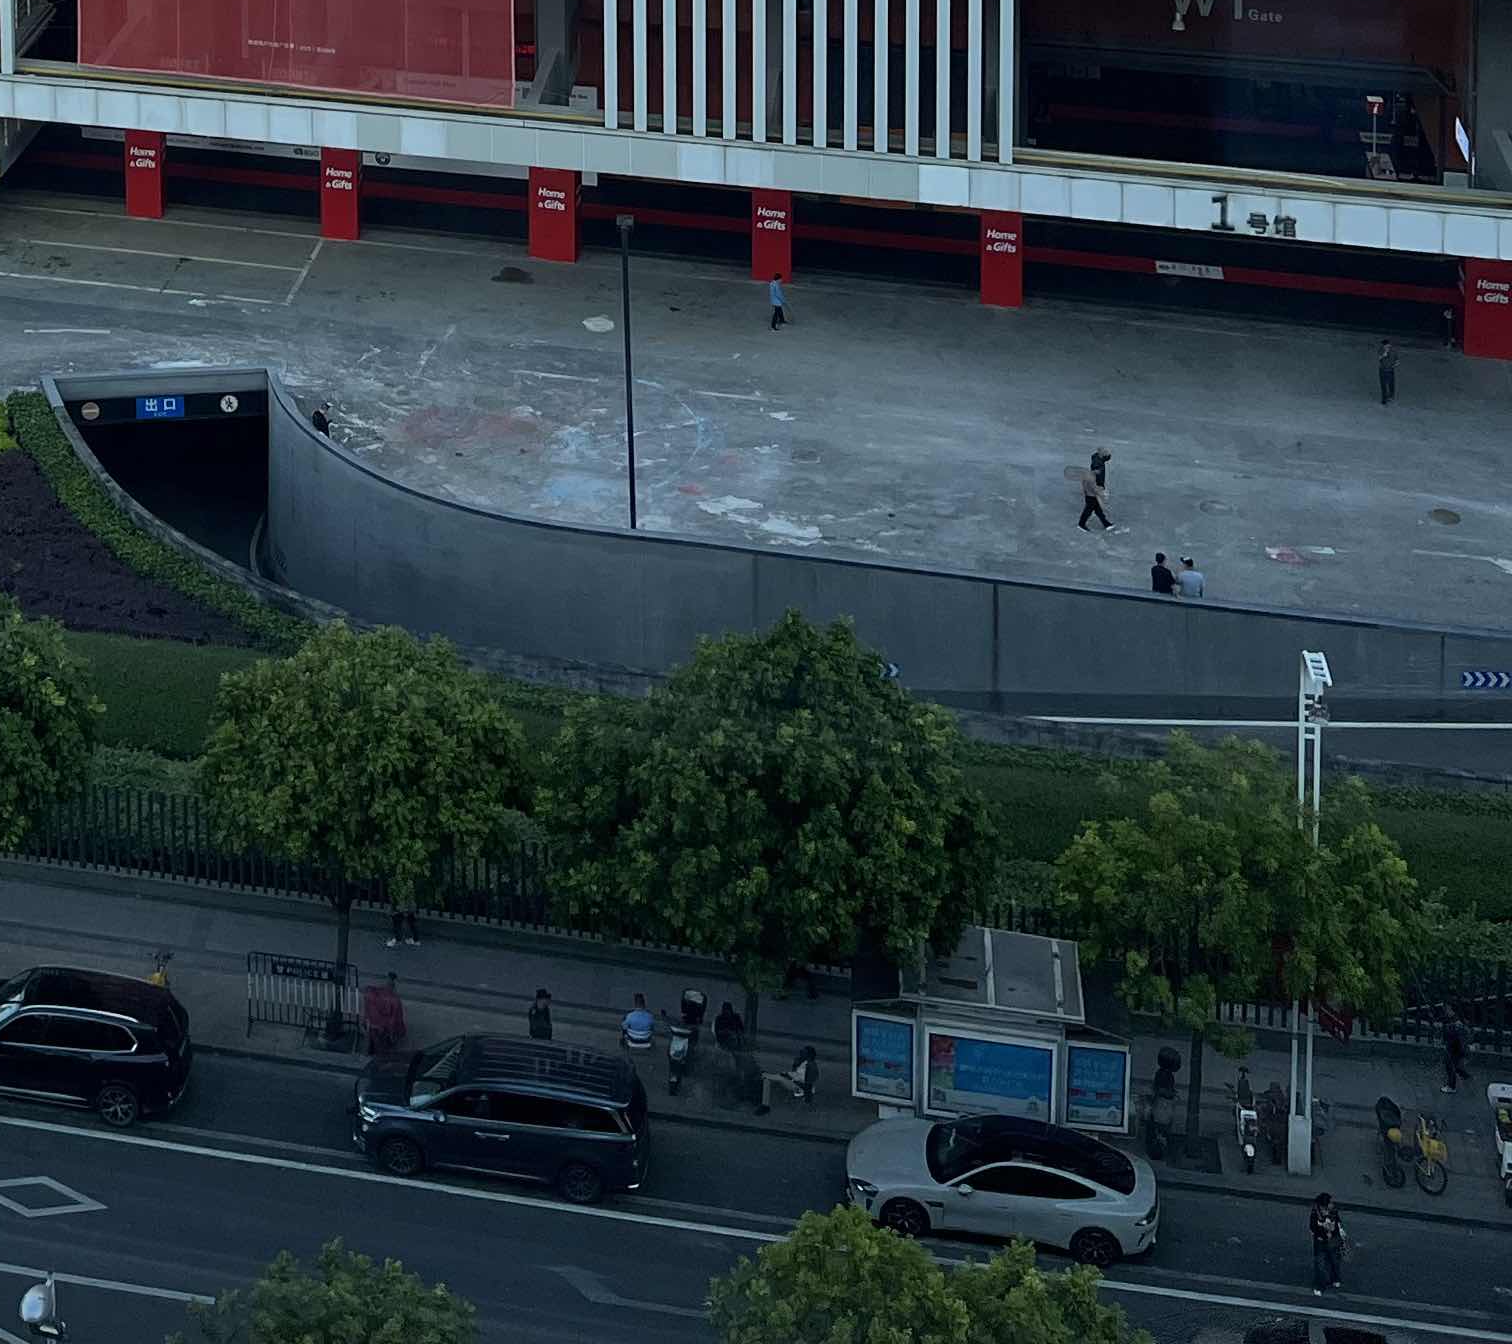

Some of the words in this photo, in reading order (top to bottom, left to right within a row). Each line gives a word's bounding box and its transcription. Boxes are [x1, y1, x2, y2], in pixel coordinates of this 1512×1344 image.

[1248, 9, 1282, 23] Gate
[538, 187, 565, 200] Home
[544, 198, 565, 212] Gifts
[757, 206, 786, 220] Home
[1211, 195, 1297, 238] 1号馆
[763, 218, 786, 232] Gifts
[987, 228, 1017, 241] Home
[993, 240, 1017, 254] Gifts
[1477, 278, 1510, 292] Home
[1483, 291, 1509, 304] Gifts
[145, 398, 176, 412] 出口
